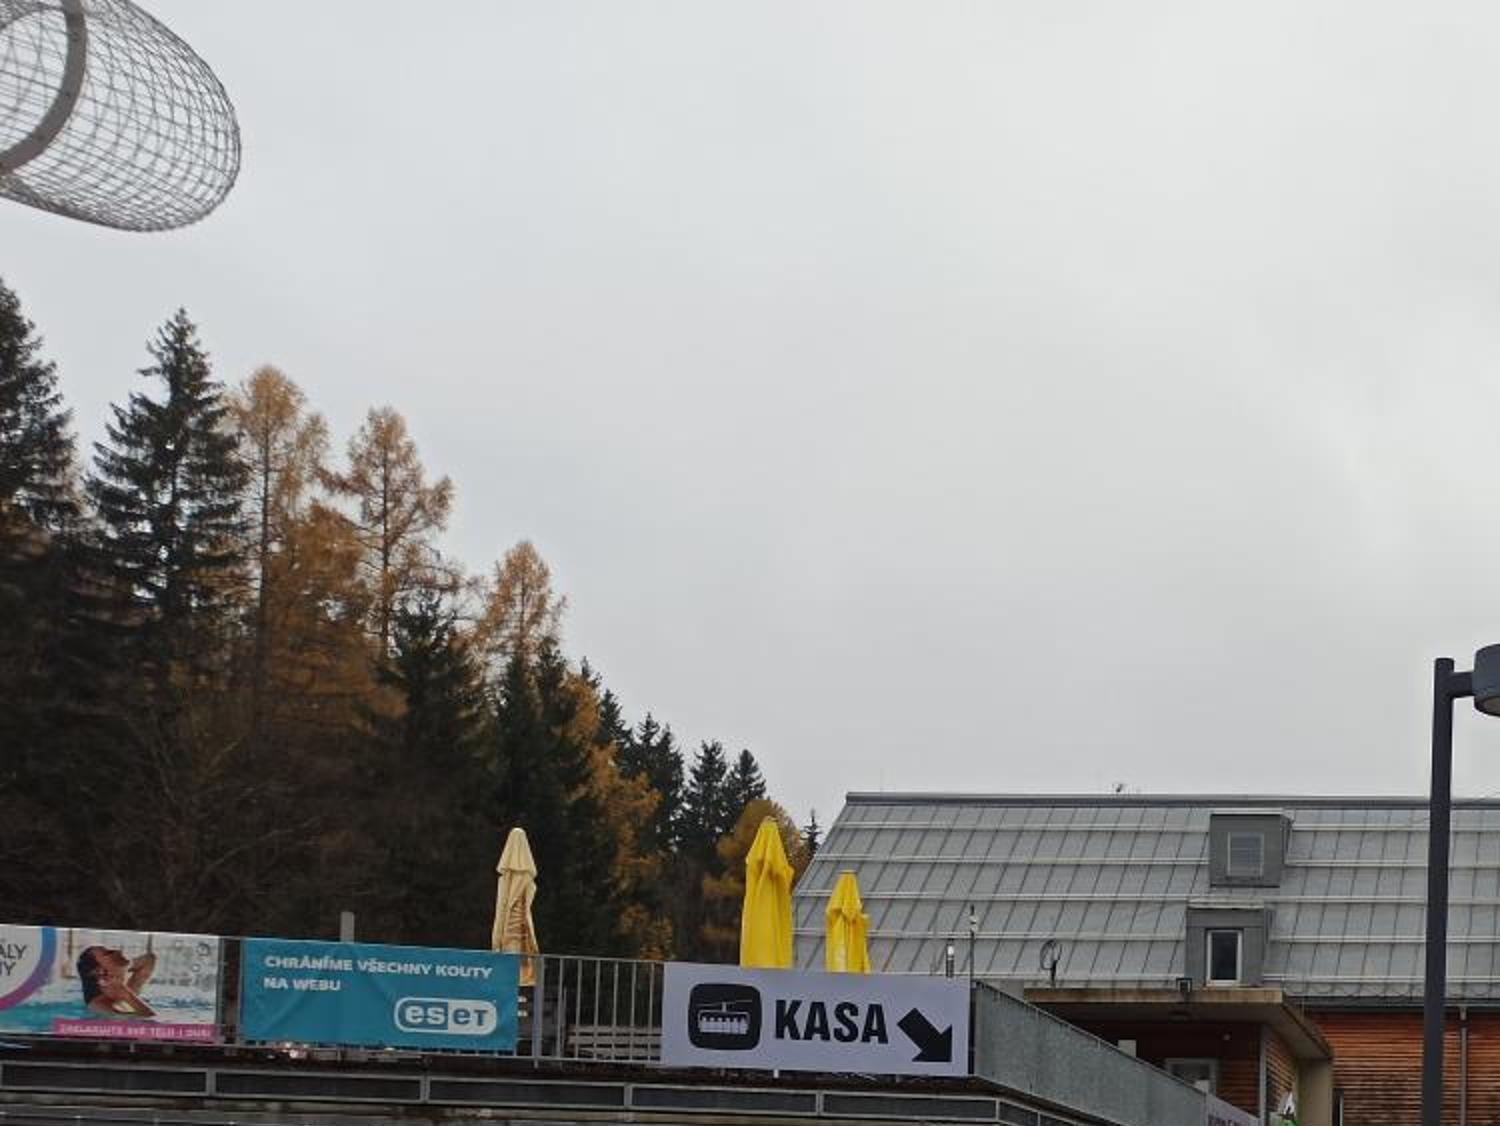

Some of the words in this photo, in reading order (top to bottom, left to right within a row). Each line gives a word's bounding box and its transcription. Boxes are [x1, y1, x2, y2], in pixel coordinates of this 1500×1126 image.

[264, 955, 353, 971] CHRÁNÍME
[357, 958, 433, 975] VŠECHNY
[435, 964, 493, 979] KOUTY
[264, 977, 289, 990] NA
[293, 978, 341, 991] WEBU
[775, 999, 889, 1044] KASA
